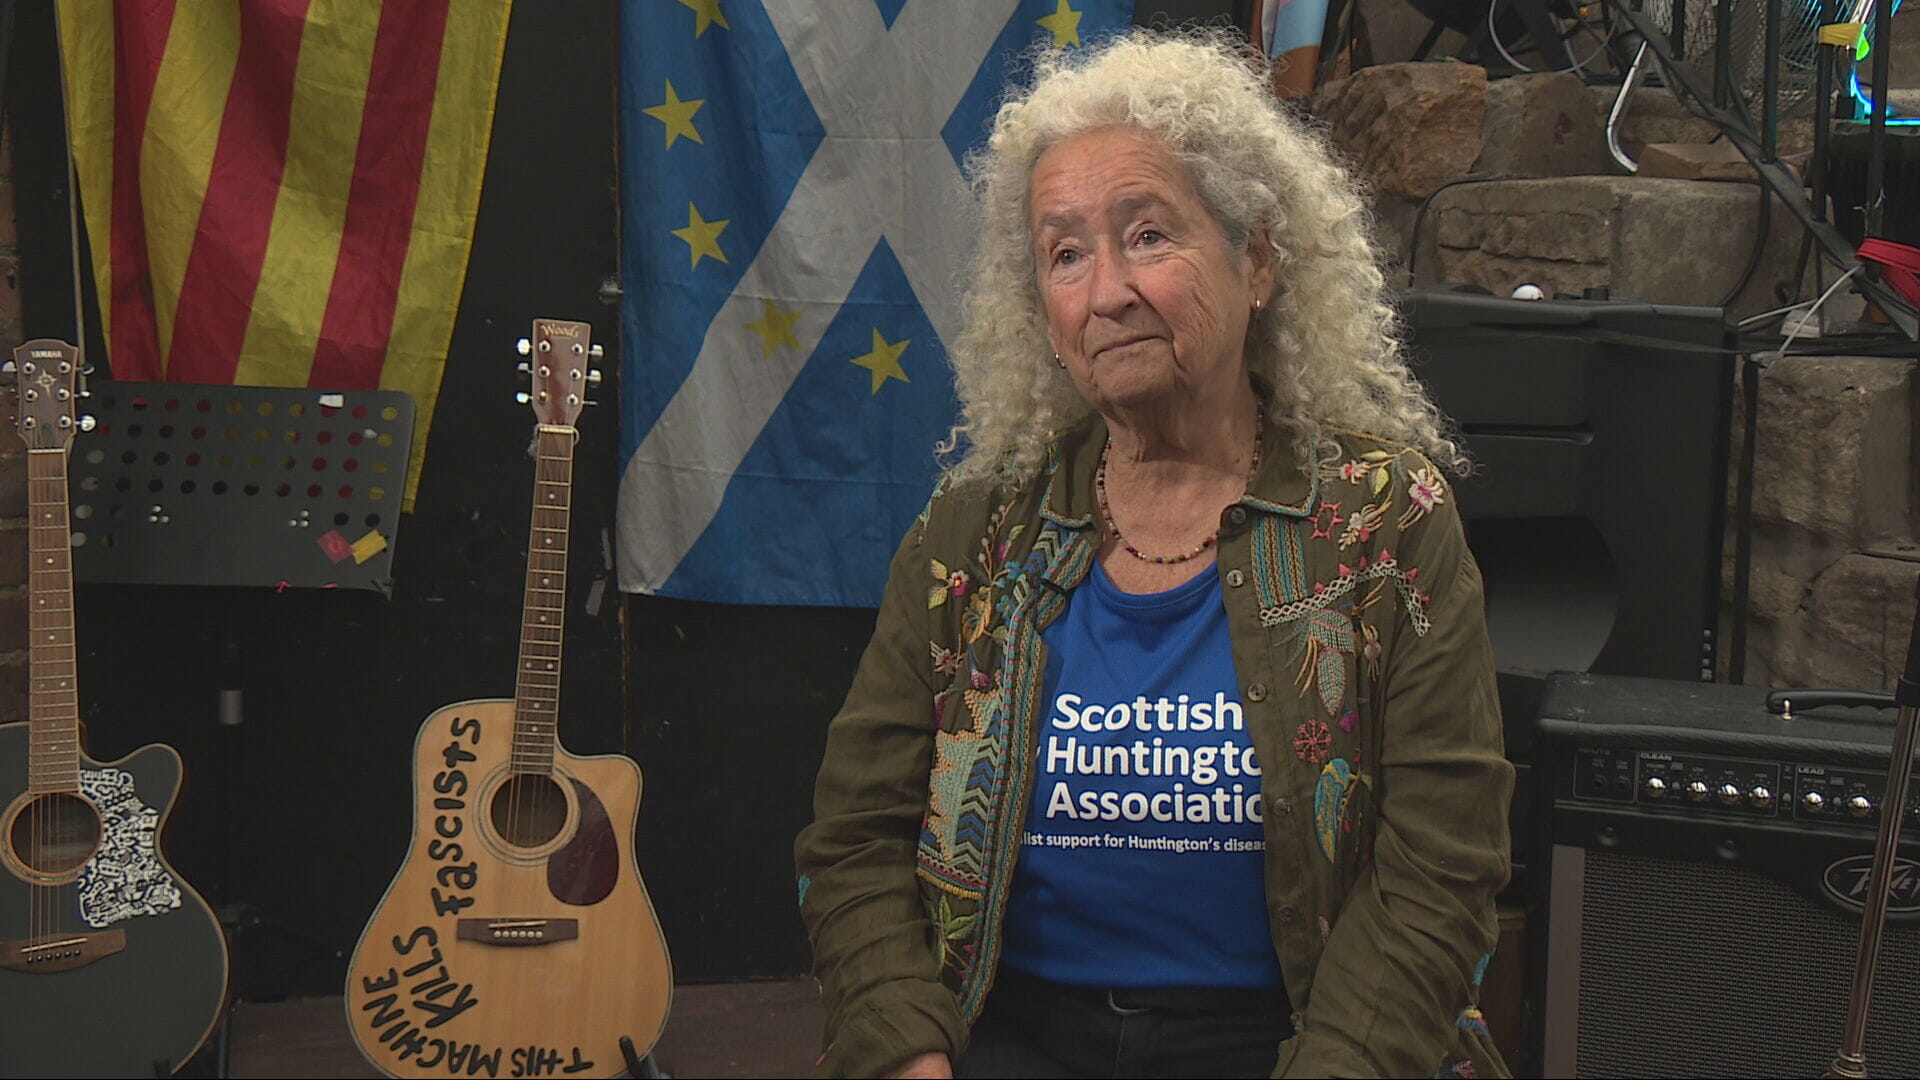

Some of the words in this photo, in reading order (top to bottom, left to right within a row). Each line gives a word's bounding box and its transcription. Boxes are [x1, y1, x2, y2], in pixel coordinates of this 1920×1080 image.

[541, 323, 580, 338] Woods
[31, 350, 63, 359] YAMAHA
[1052, 692, 1244, 732] Scottish
[1640, 752, 1672, 761] CLEAN
[1798, 767, 1824, 776] LEAD
[1046, 834, 1101, 849] support
[1103, 833, 1125, 848] for
[392, 926, 478, 1028] KILLS
[363, 968, 502, 1077] MACHINE
[511, 1046, 594, 1077] THIS
